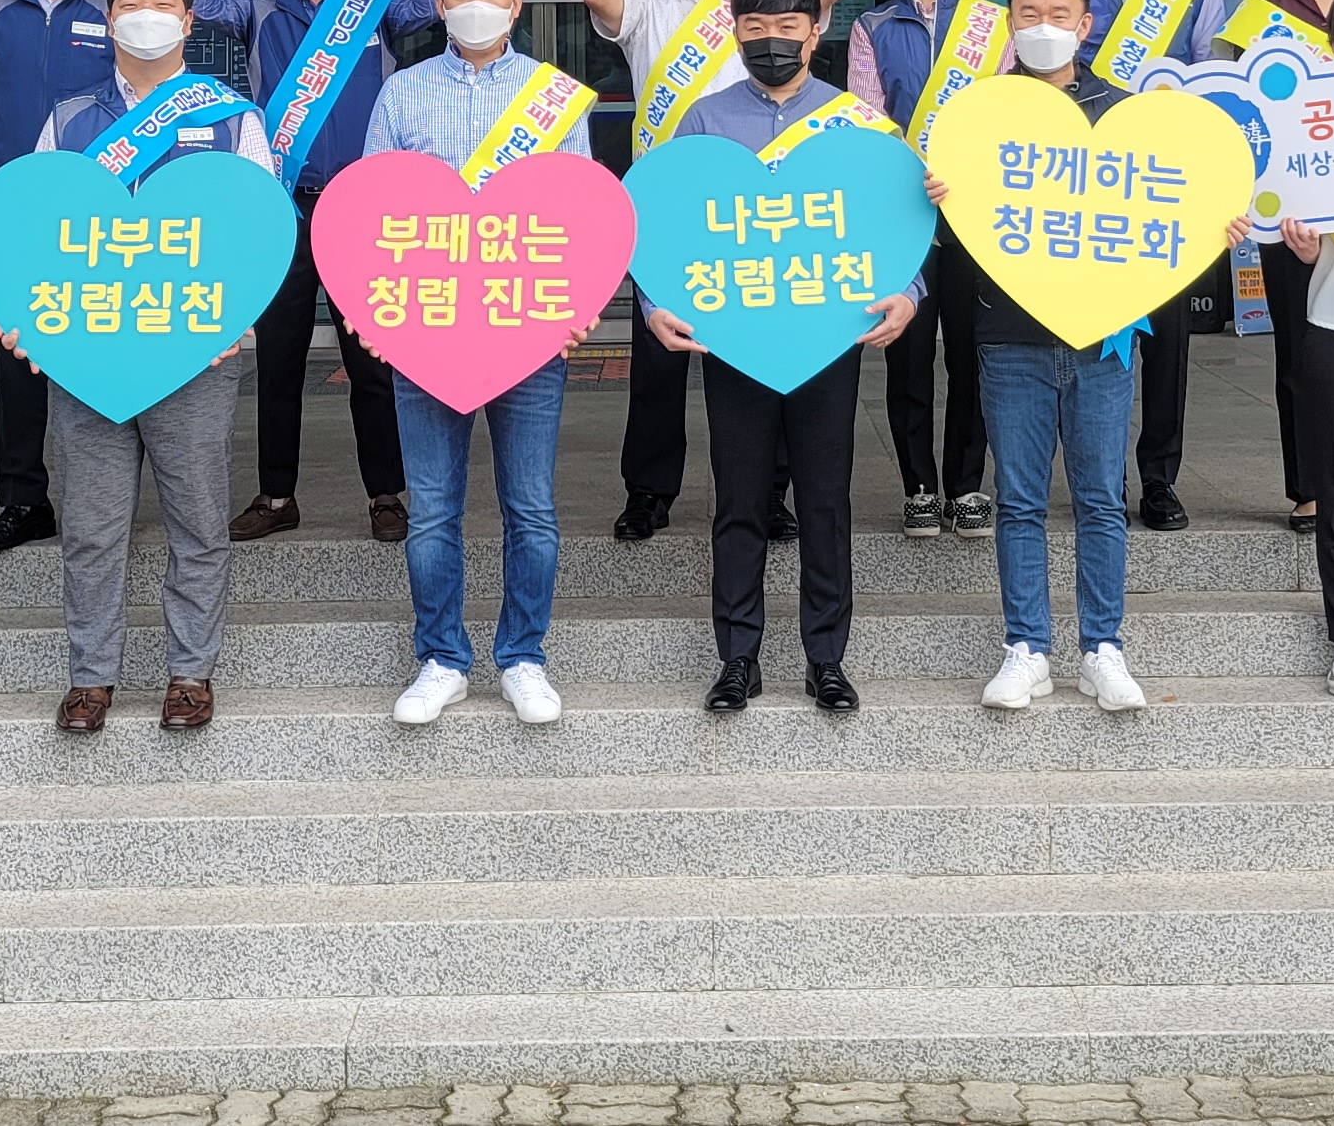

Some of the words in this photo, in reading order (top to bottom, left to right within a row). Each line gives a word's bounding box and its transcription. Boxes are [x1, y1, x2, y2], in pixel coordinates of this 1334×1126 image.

[956, 3, 998, 70] 부정부패
[1112, 39, 1147, 80] 청정
[667, 45, 706, 86] 없는
[273, 51, 339, 155] 부패ZER
[526, 74, 579, 131] 정부패
[647, 84, 676, 127] 청정
[998, 140, 1187, 203] 함께하는
[58, 216, 202, 269] 나부터
[375, 214, 569, 264] 부패없는
[706, 190, 845, 245] 나부터
[993, 204, 1186, 269] 청렴문화
[29, 281, 224, 335] 청렴실천
[367, 276, 457, 328] 청렴
[481, 277, 575, 327] 진도
[684, 251, 875, 312] 청렴실천
